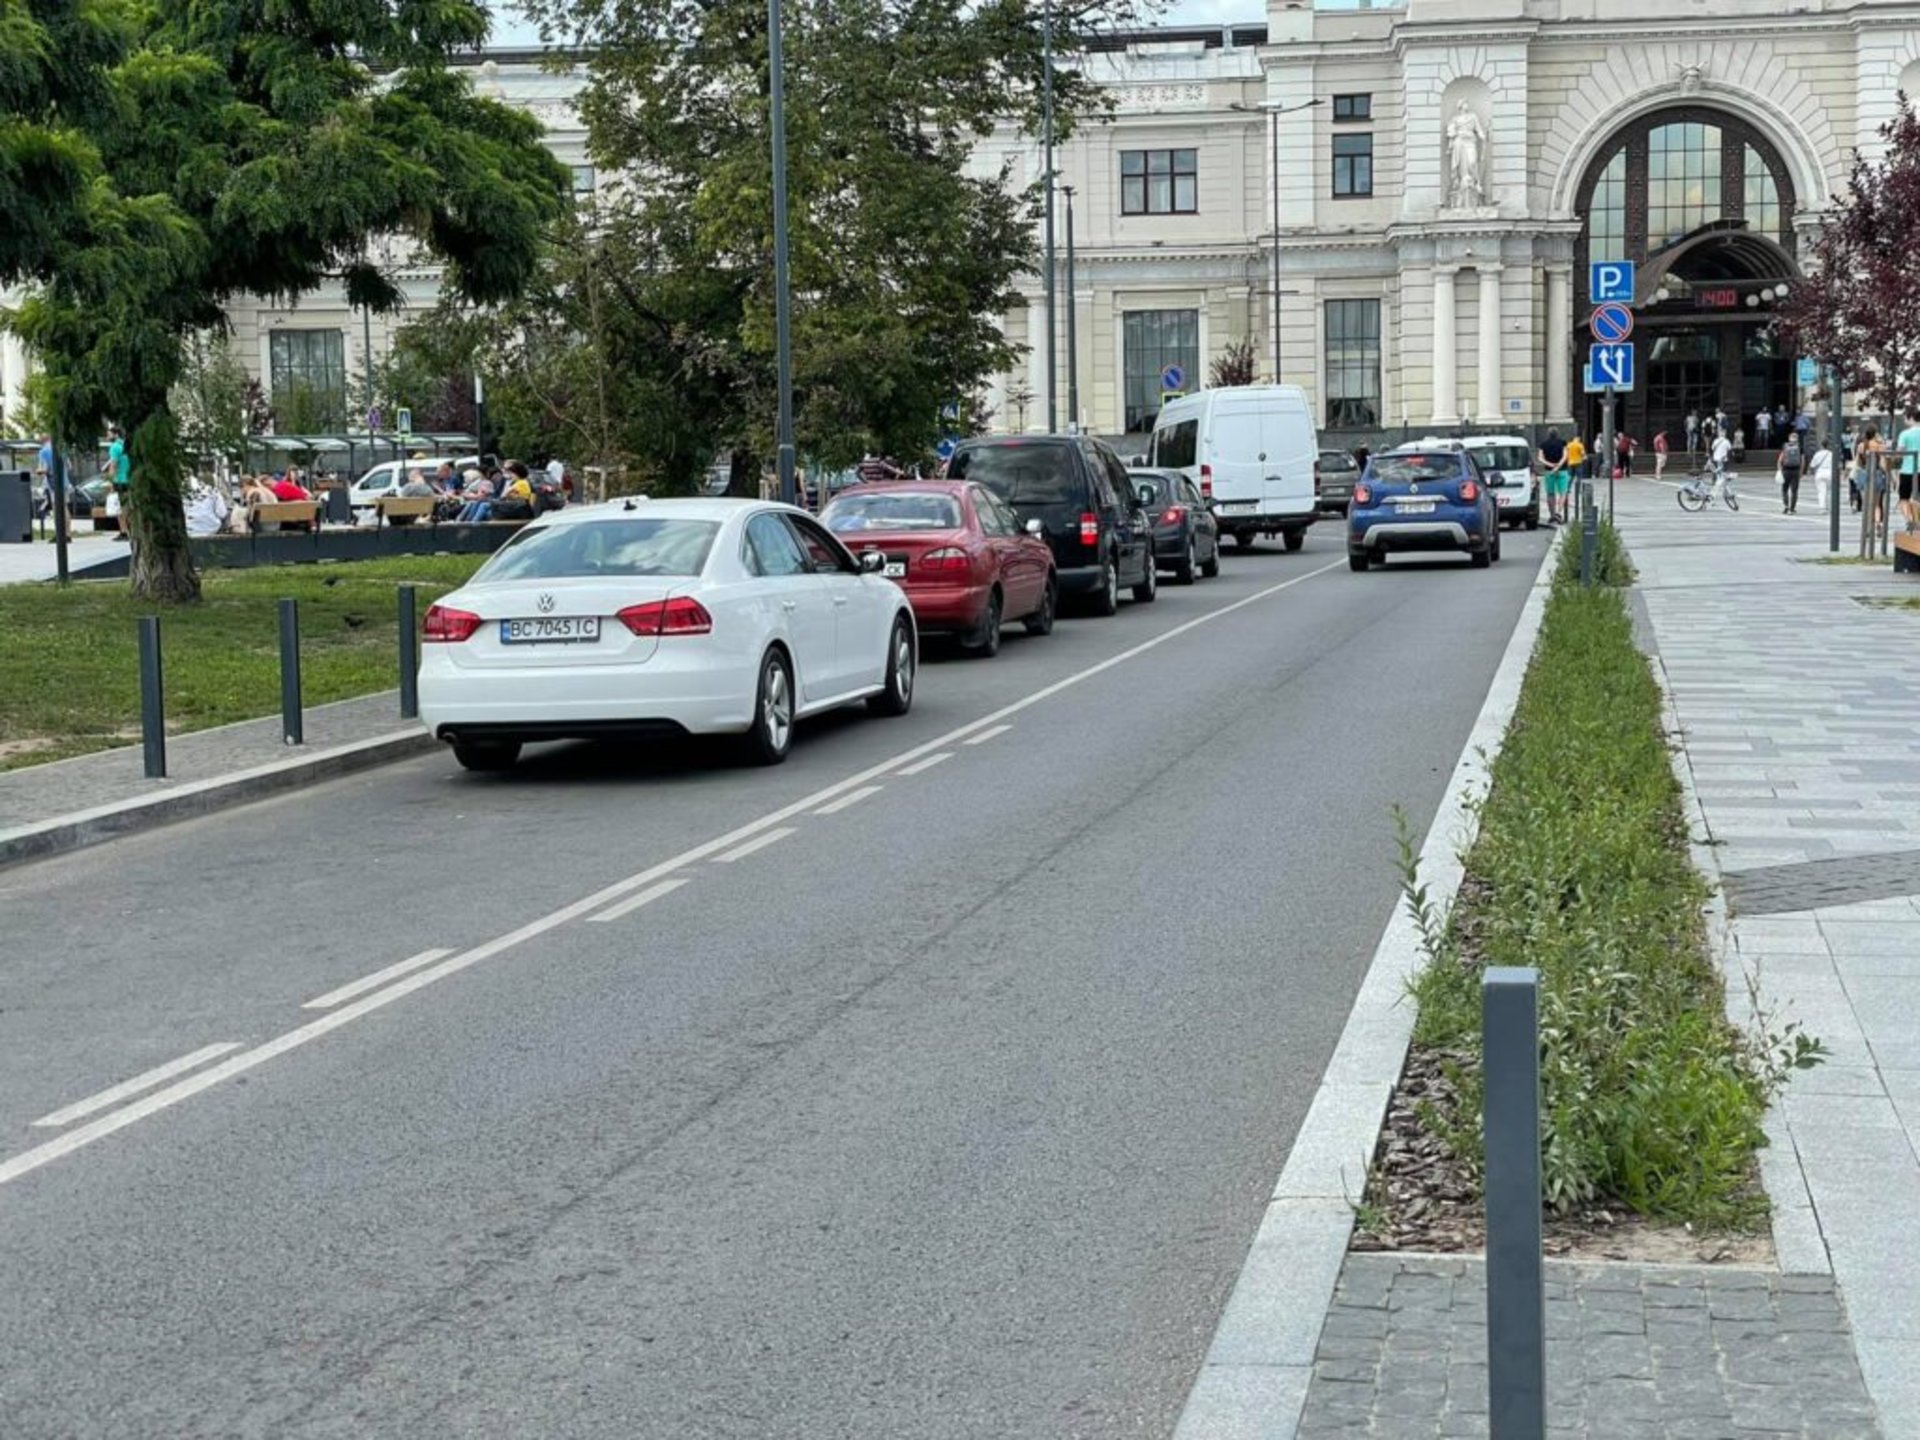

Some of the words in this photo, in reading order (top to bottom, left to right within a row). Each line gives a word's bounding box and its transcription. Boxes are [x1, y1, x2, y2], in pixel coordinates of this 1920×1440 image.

[1599, 266, 1622, 298] P
[511, 622, 532, 637] BC
[536, 620, 571, 636] 7045
[576, 619, 595, 634] IC
